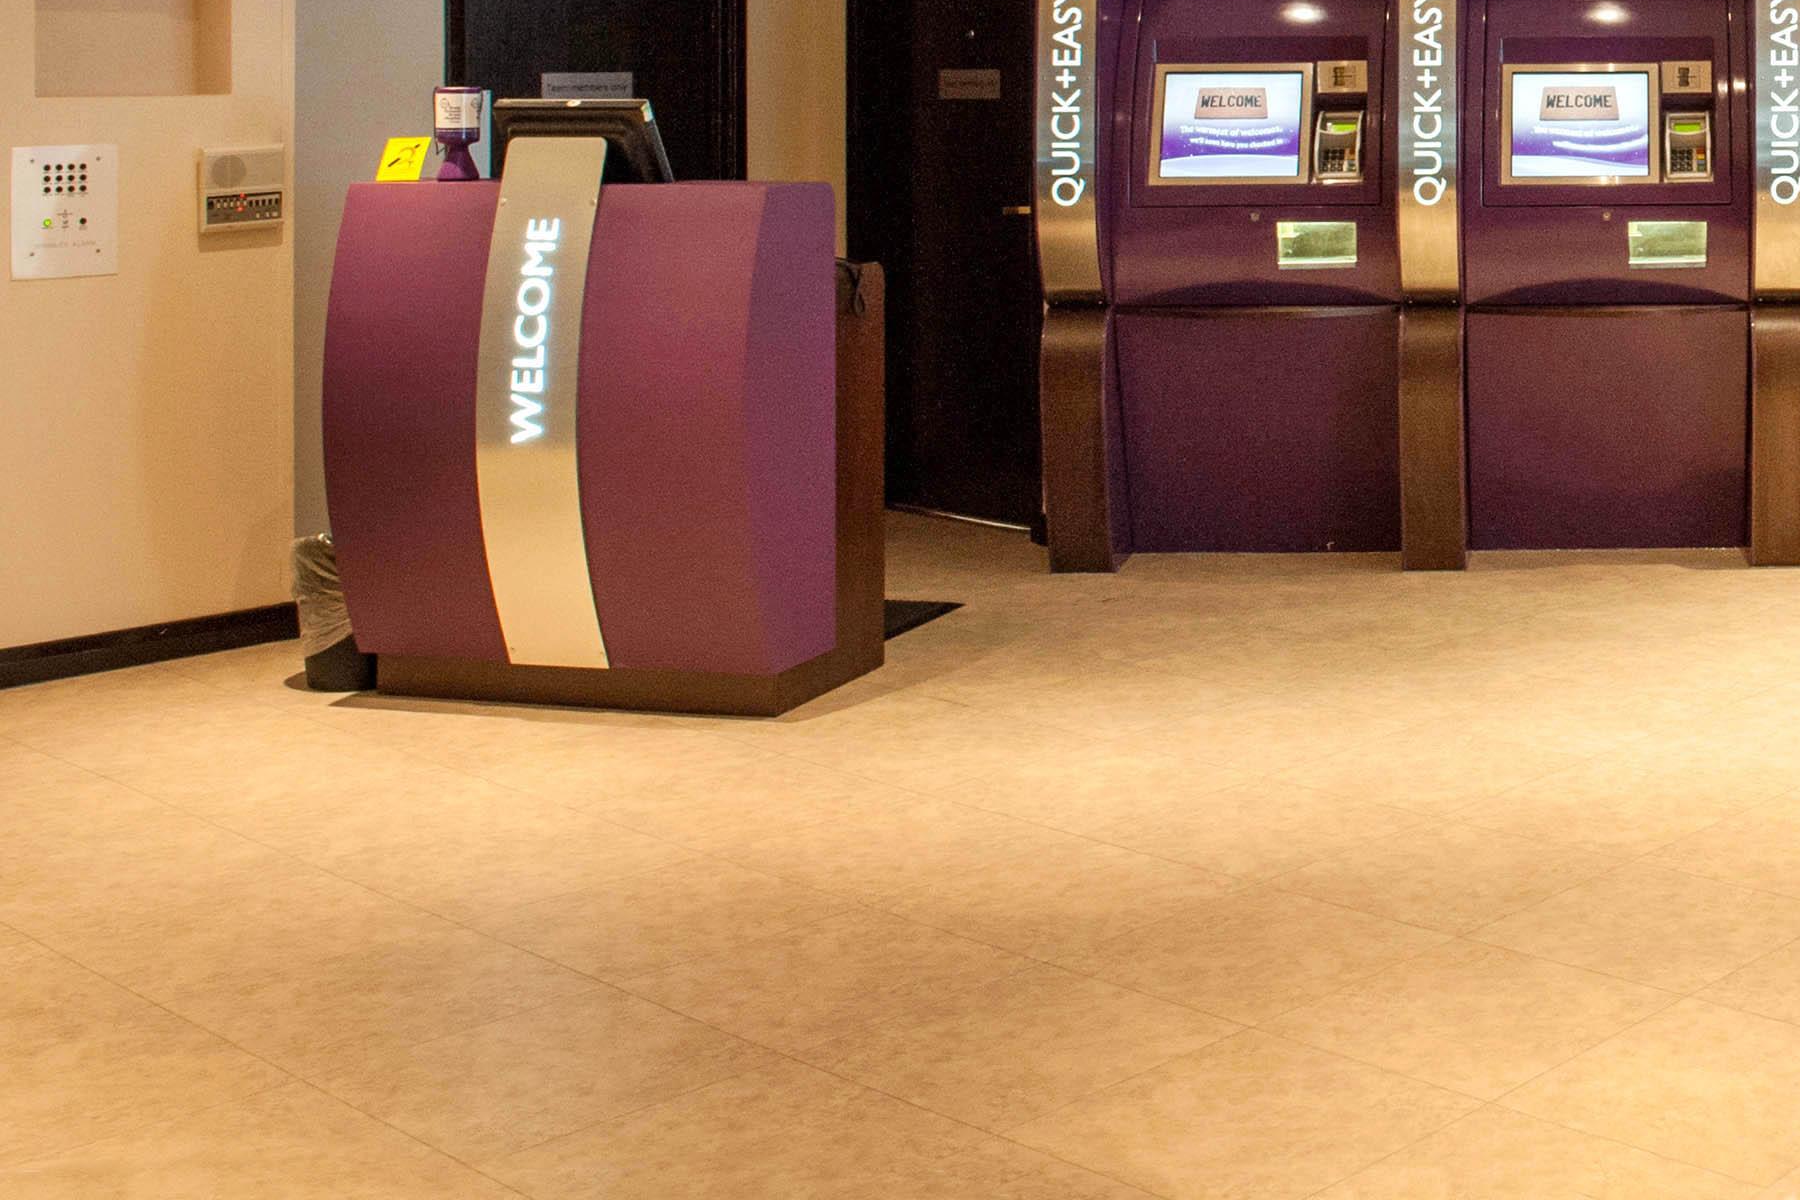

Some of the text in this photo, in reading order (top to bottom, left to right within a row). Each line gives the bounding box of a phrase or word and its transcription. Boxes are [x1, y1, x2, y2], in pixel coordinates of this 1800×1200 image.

[1200, 95, 1262, 108] WELCOME
[1545, 94, 1612, 109] WELCOME
[510, 216, 561, 445] WELCOME
